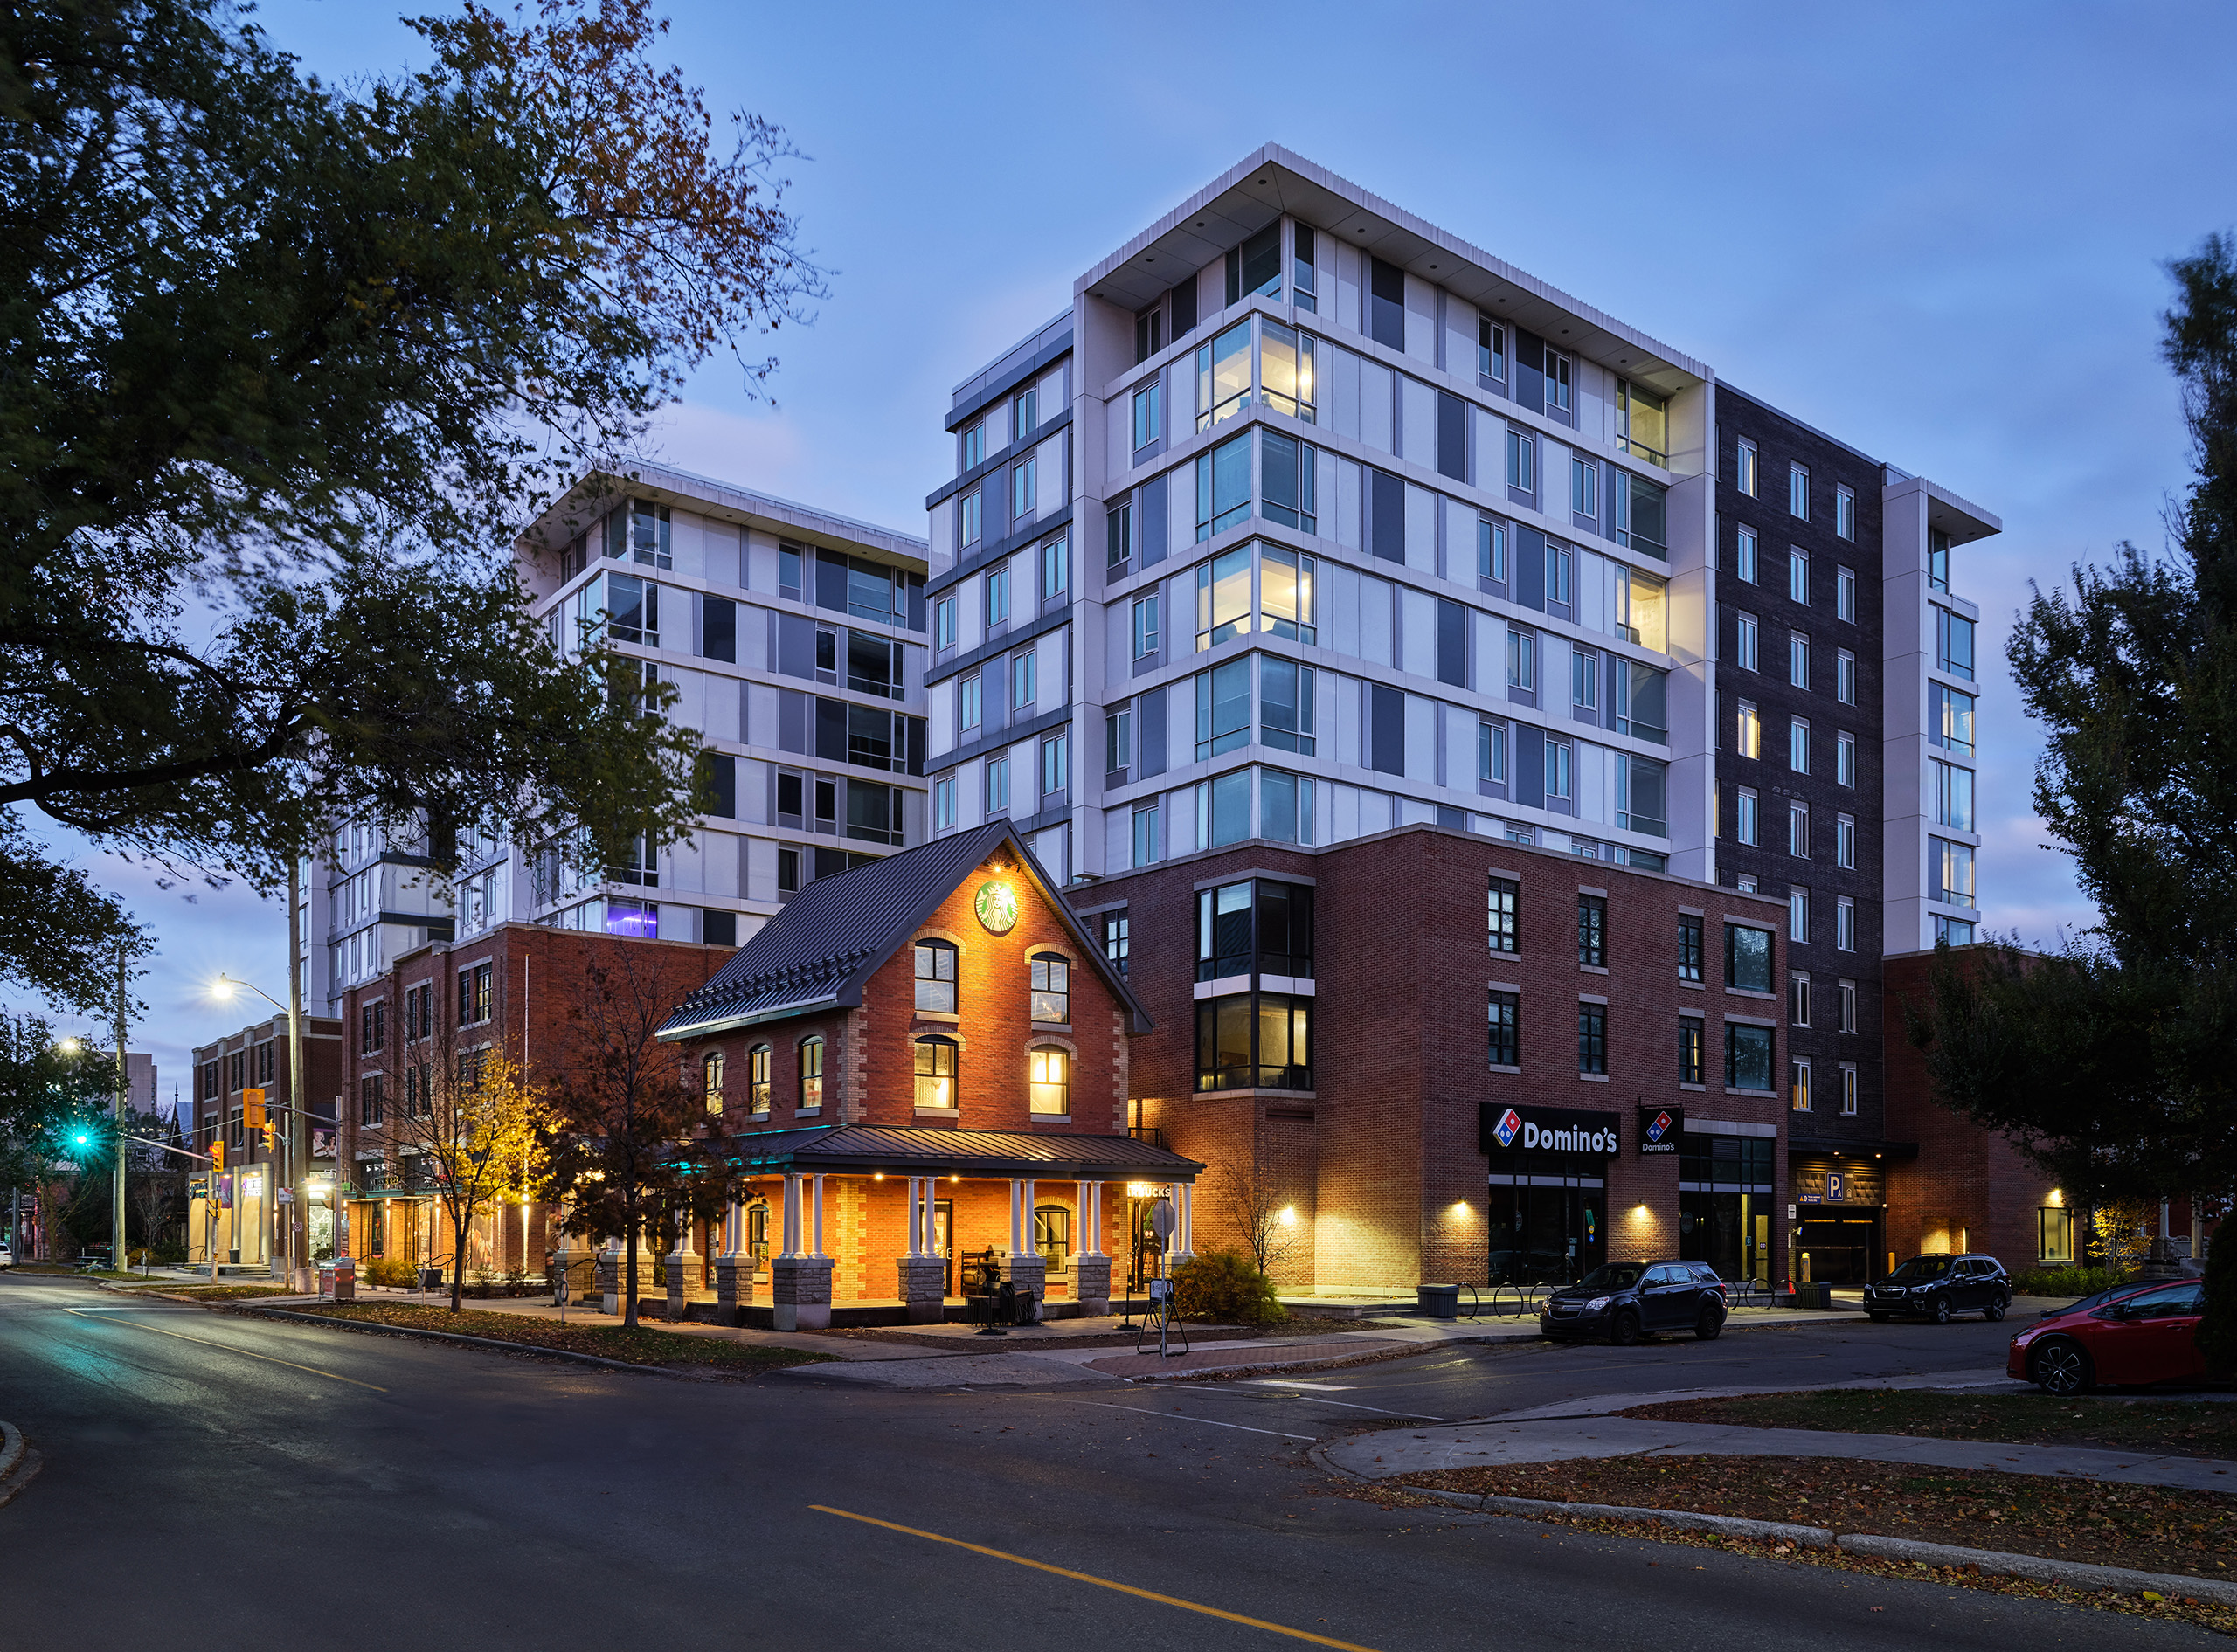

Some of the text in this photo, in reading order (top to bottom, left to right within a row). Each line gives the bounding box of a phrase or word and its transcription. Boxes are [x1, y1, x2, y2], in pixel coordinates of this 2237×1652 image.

[1524, 1122, 1617, 1153] Domino's
[1642, 1142, 1675, 1151] Domino's
[1830, 1176, 1840, 1198] P
